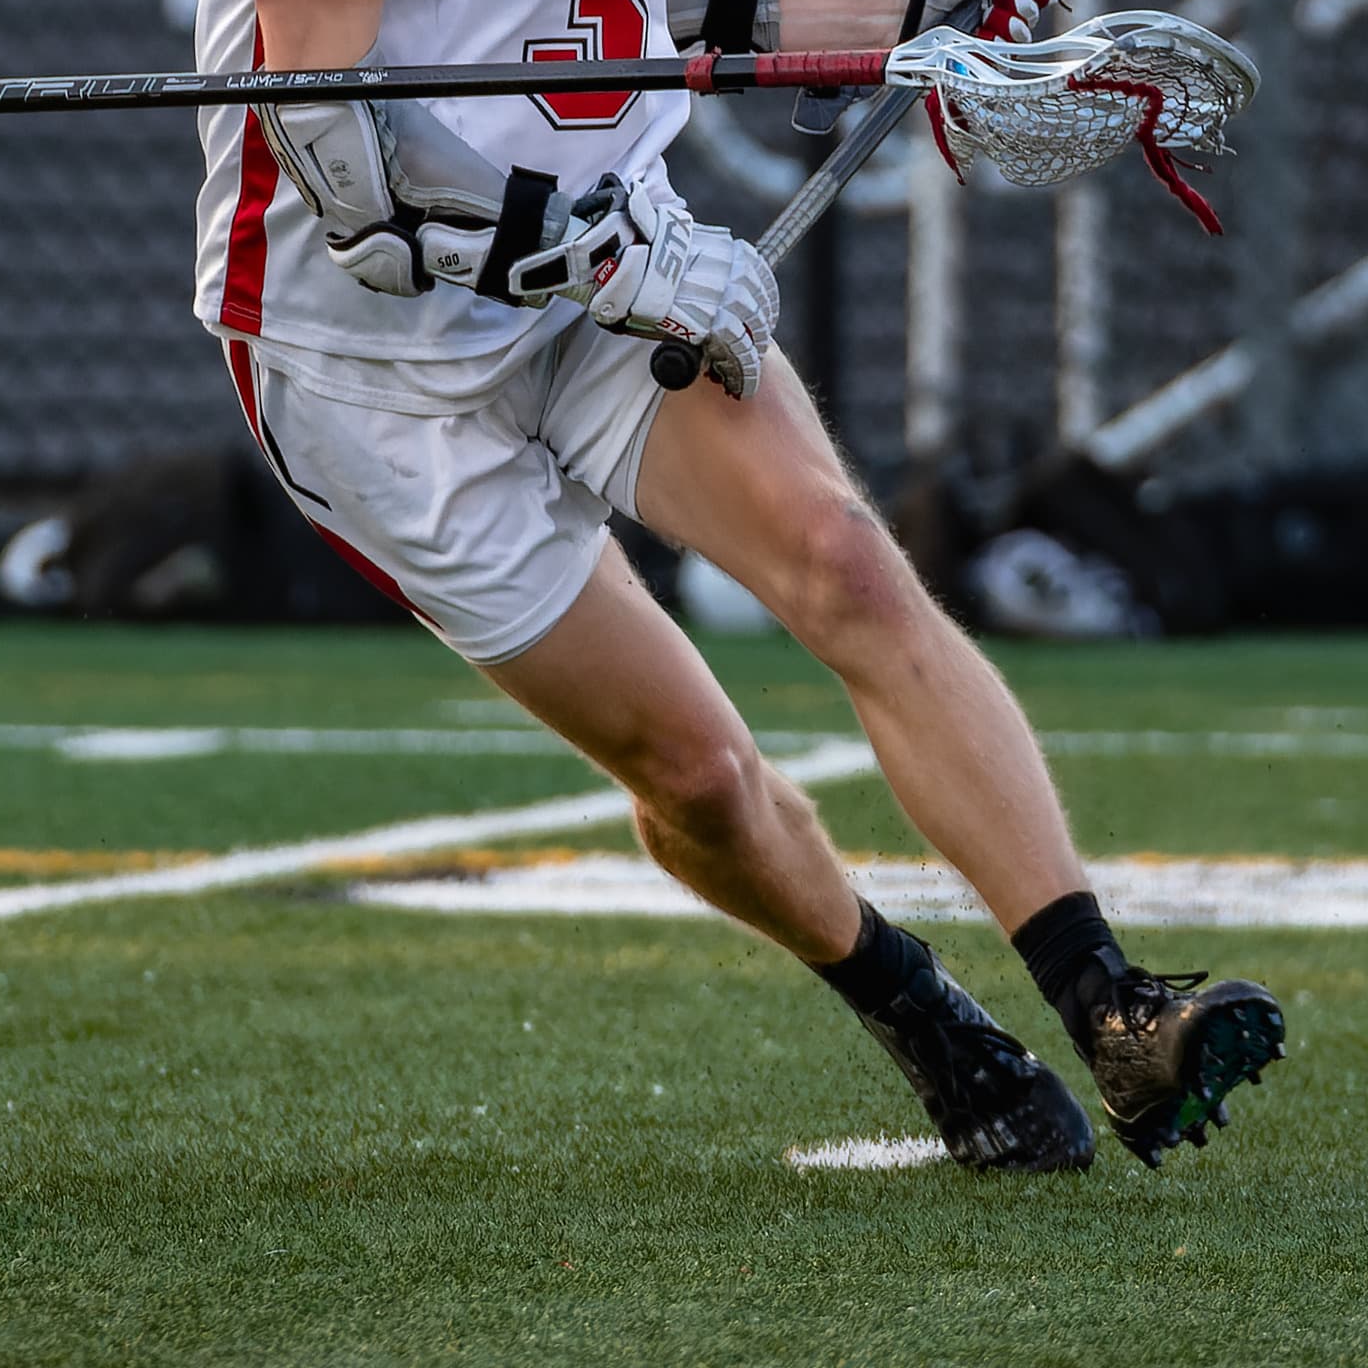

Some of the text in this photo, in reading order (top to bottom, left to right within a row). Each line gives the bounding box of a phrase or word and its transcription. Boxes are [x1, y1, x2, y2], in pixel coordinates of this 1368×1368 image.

[436, 252, 460, 269] 500
[654, 210, 692, 288] STX
[655, 316, 697, 342] STX
